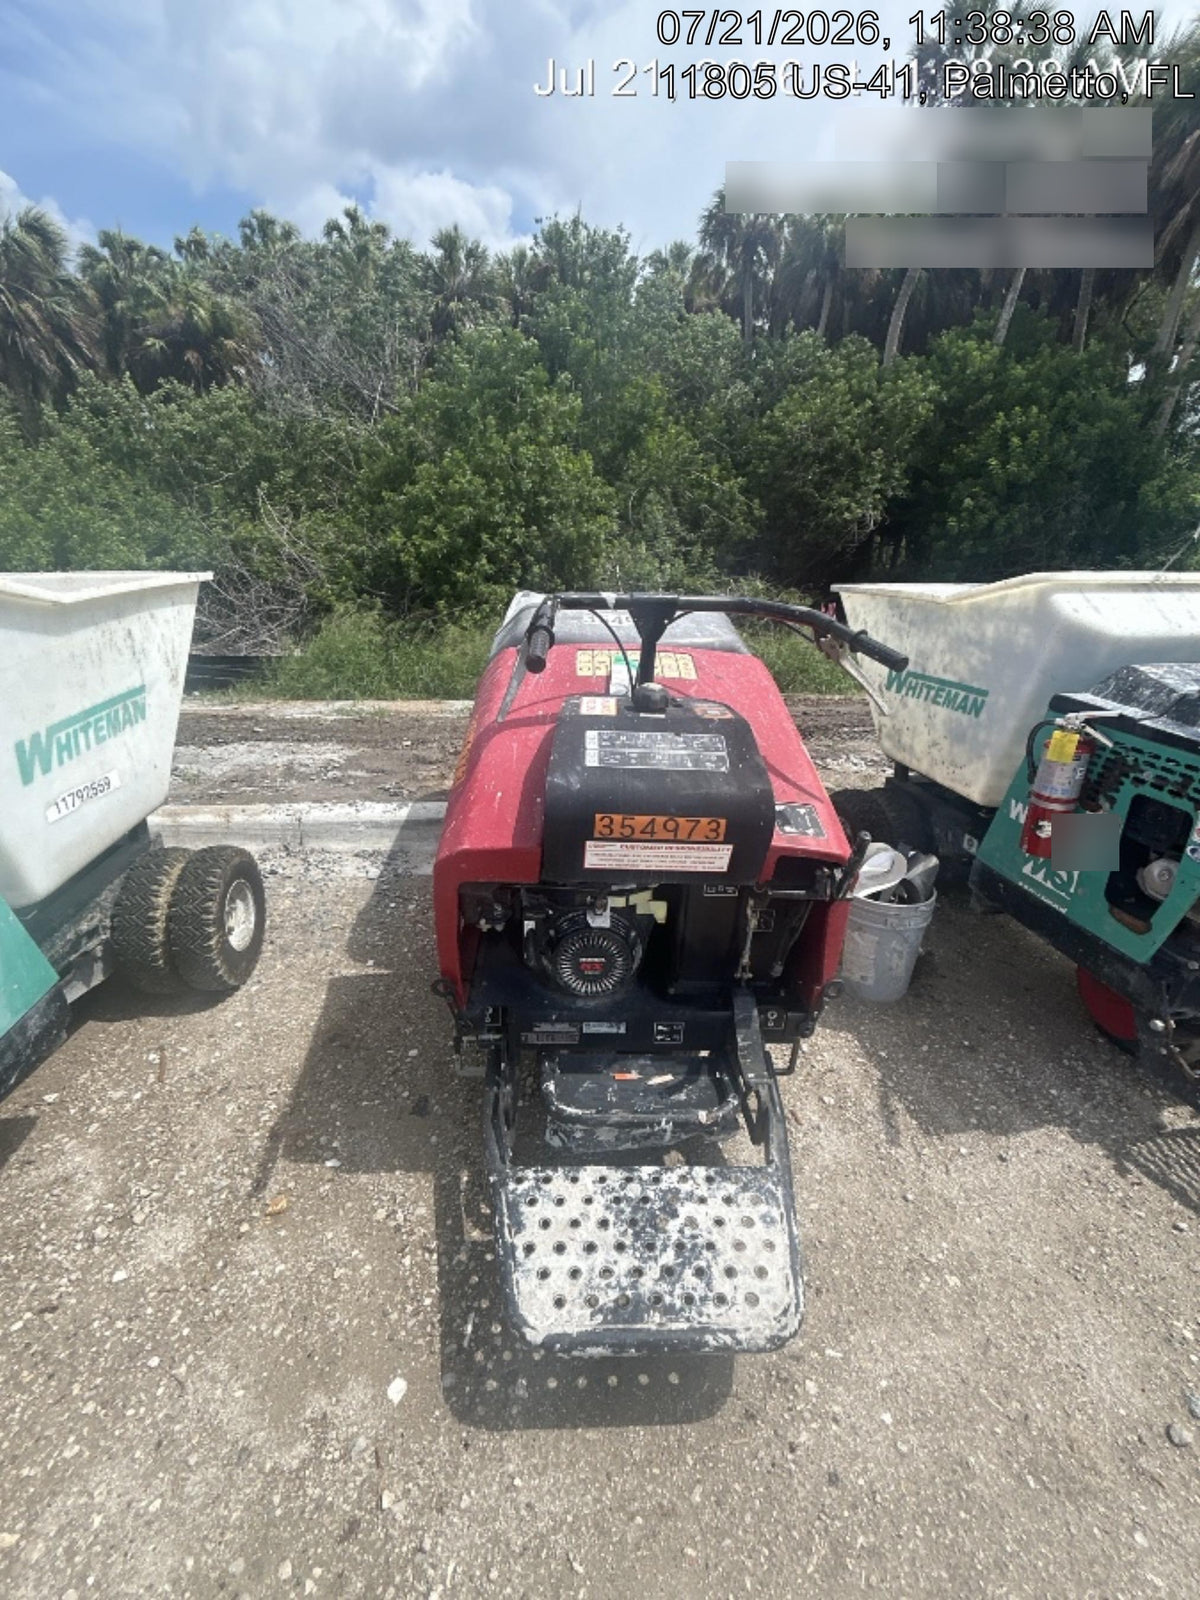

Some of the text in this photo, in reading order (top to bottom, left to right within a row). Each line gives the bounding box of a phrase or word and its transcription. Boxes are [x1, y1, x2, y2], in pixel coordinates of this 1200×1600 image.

[885, 668, 988, 718] WHITEMAN
[14, 684, 147, 787] WHITEMAN
[598, 814, 721, 840] 354973
